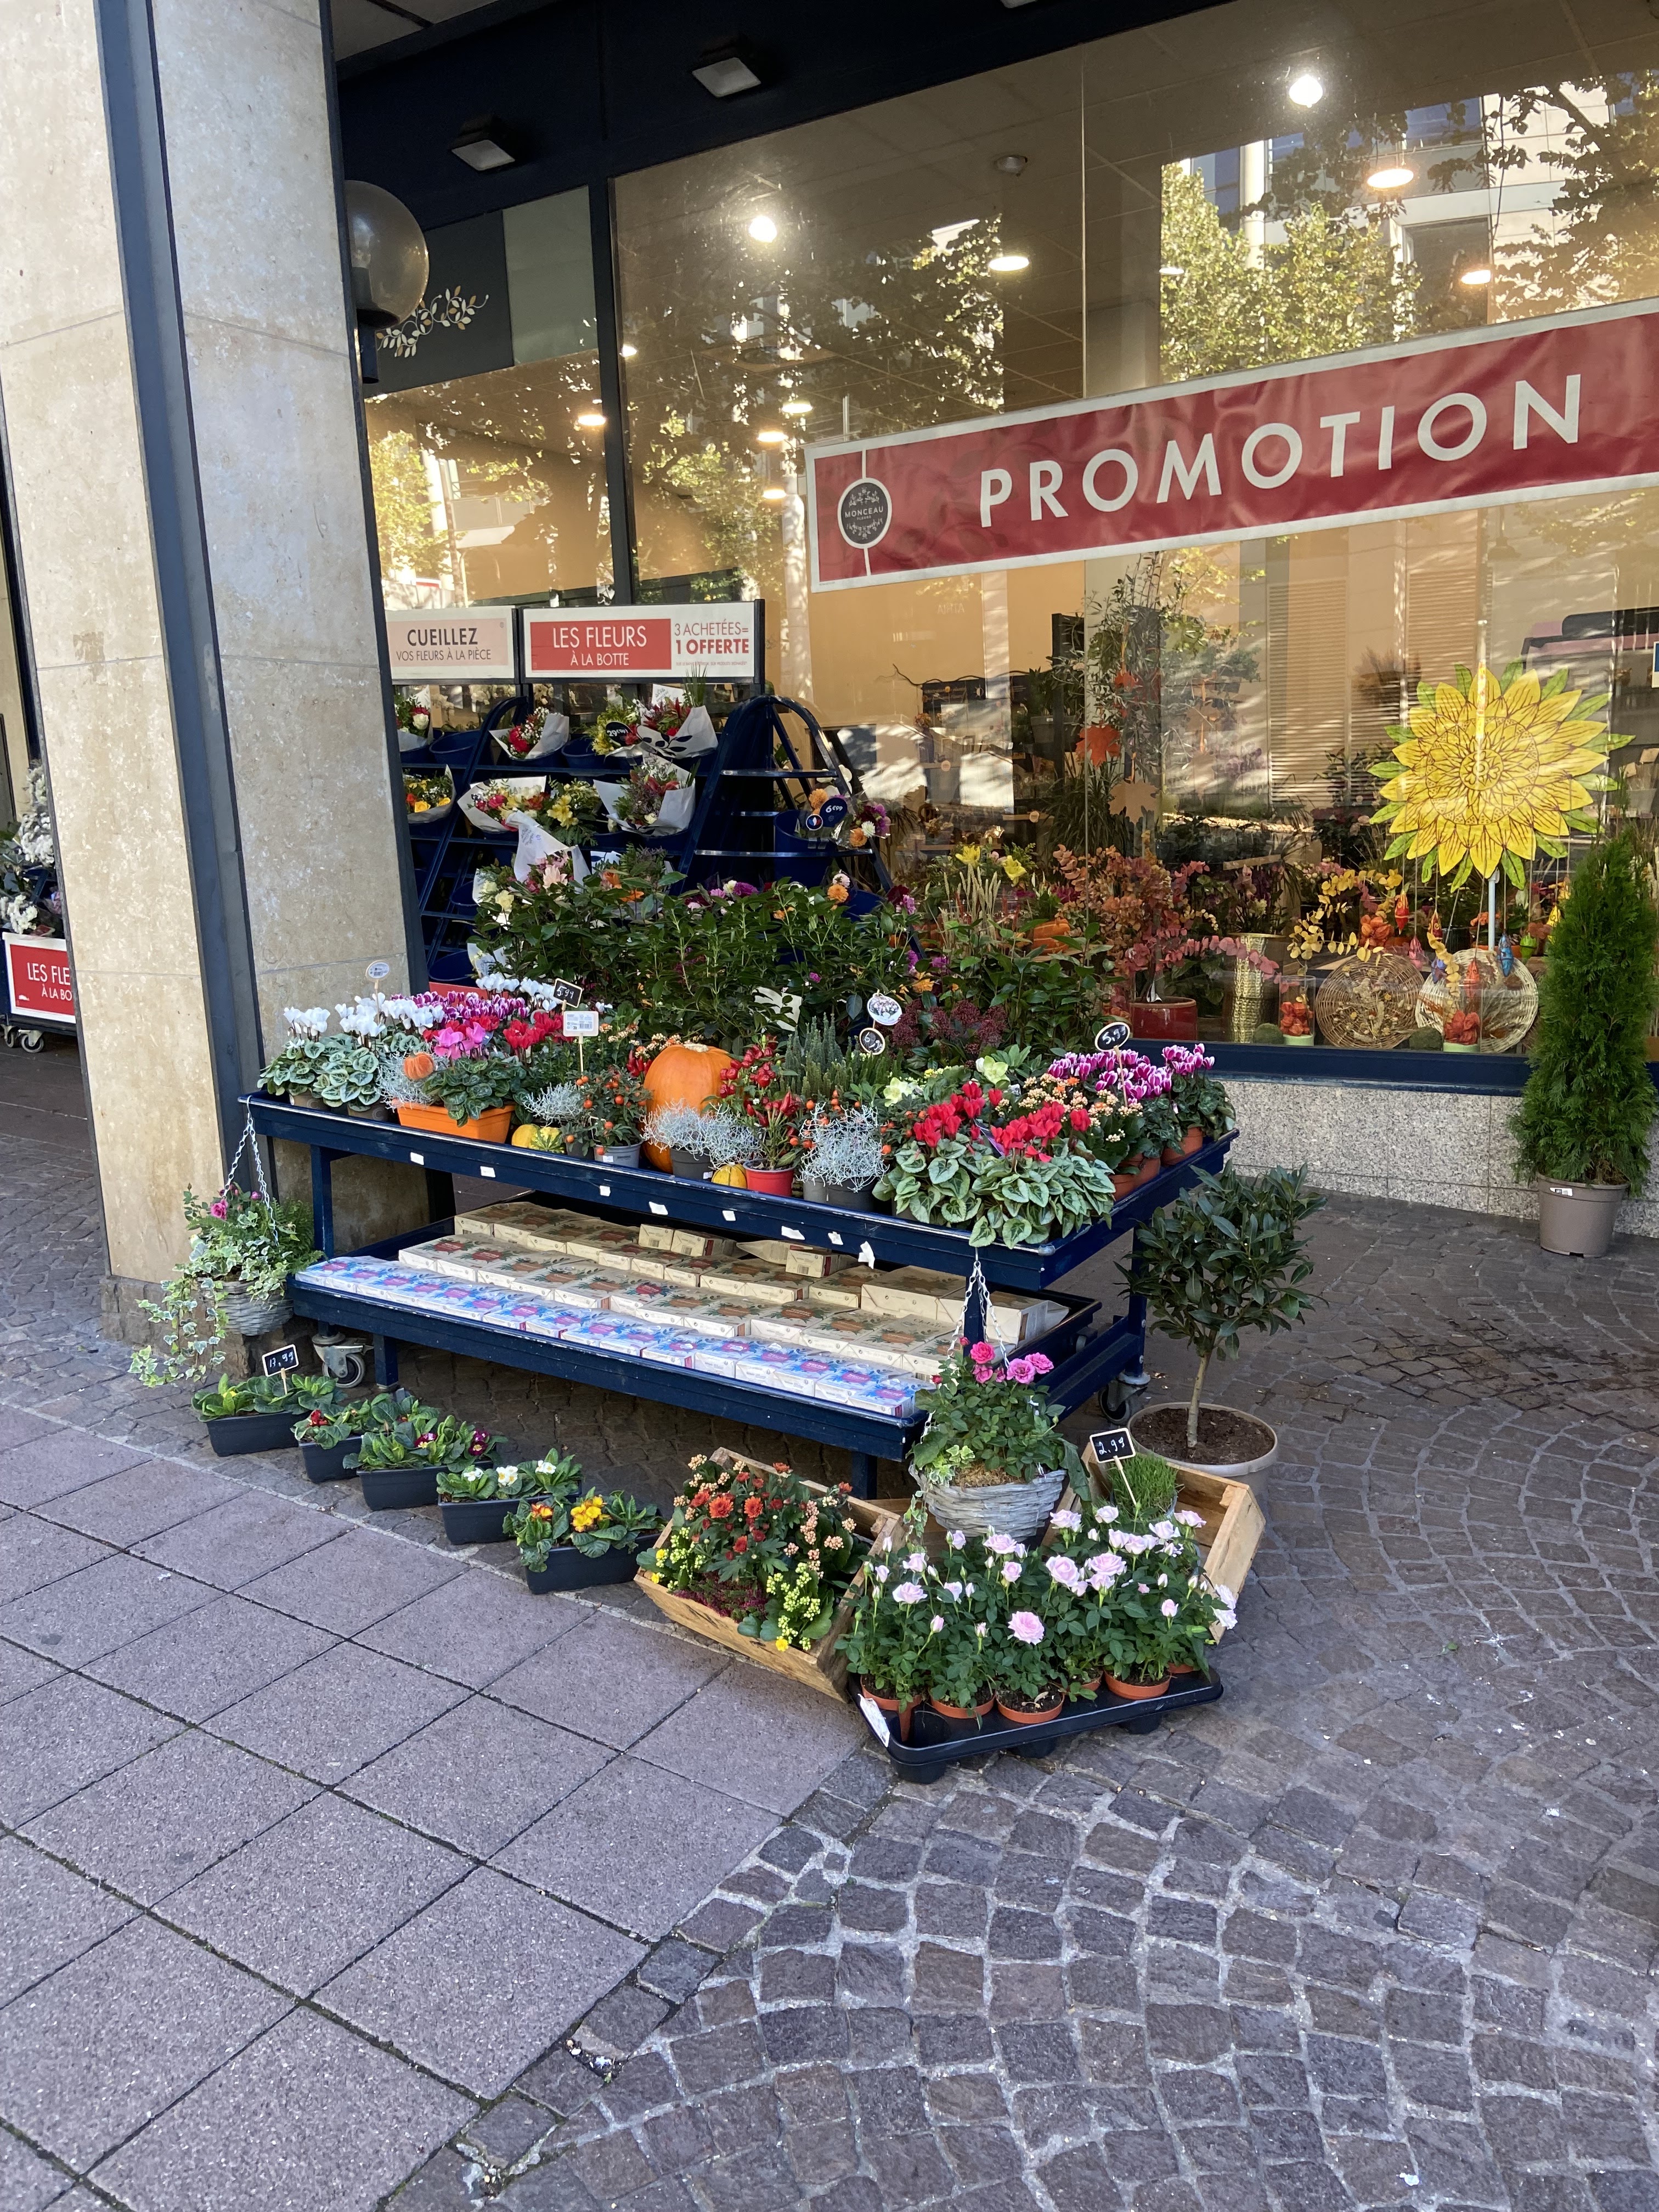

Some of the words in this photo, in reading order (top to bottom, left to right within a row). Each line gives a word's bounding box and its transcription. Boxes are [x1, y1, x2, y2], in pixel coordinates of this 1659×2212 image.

[979, 374, 1582, 528] PROMOTION
[844, 505, 884, 518] MONCEAU
[407, 627, 478, 646] CUEILLEZ
[553, 627, 580, 648] LES
[586, 625, 647, 648] FLEURS
[674, 623, 681, 636] 3
[396, 651, 413, 661] VOS
[416, 650, 444, 661] FLEURS
[447, 647, 453, 661] À
[455, 650, 465, 660] LA
[468, 646, 491, 660] PIÈCE
[676, 640, 681, 654] 1
[686, 639, 749, 654] OFFERTE
[570, 650, 579, 665] À
[581, 653, 594, 665] LA
[596, 652, 629, 665] BOTTE
[27, 962, 48, 983] LES
[51, 965, 71, 985] FLE
[41, 983, 48, 998] À
[49, 988, 59, 1000] LA
[60, 989, 72, 1001] BO
